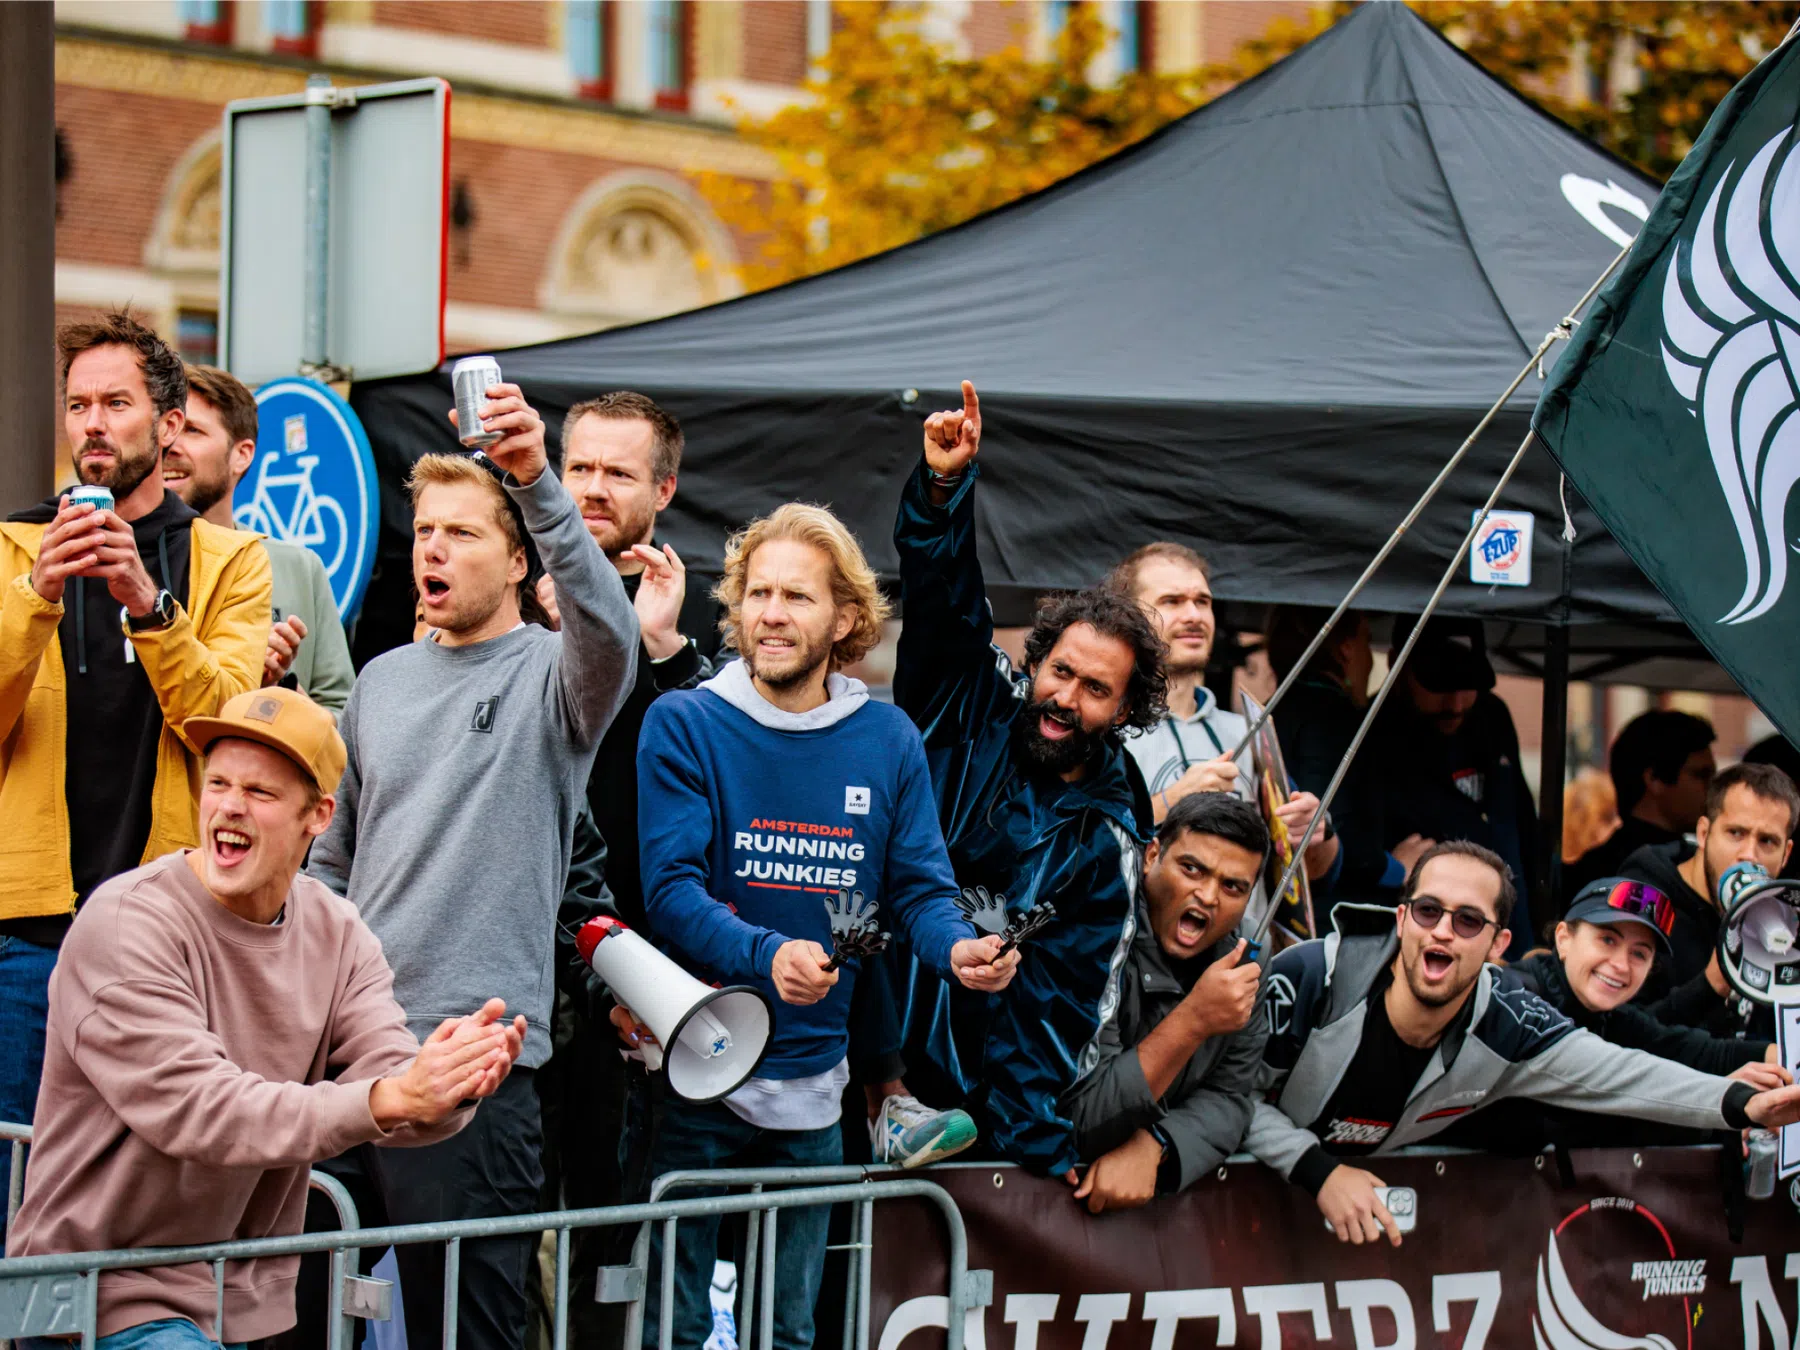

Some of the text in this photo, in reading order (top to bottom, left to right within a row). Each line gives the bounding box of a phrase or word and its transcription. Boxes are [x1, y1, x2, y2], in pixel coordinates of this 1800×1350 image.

[750, 818, 853, 838] AMSTERDAM
[734, 831, 865, 862] RUNNING
[734, 860, 857, 887] JUNKIES
[1590, 1197, 1616, 1210] SINCE
[1631, 1259, 1707, 1281] RUNNING
[1642, 1274, 1707, 1301] JUNKIES
